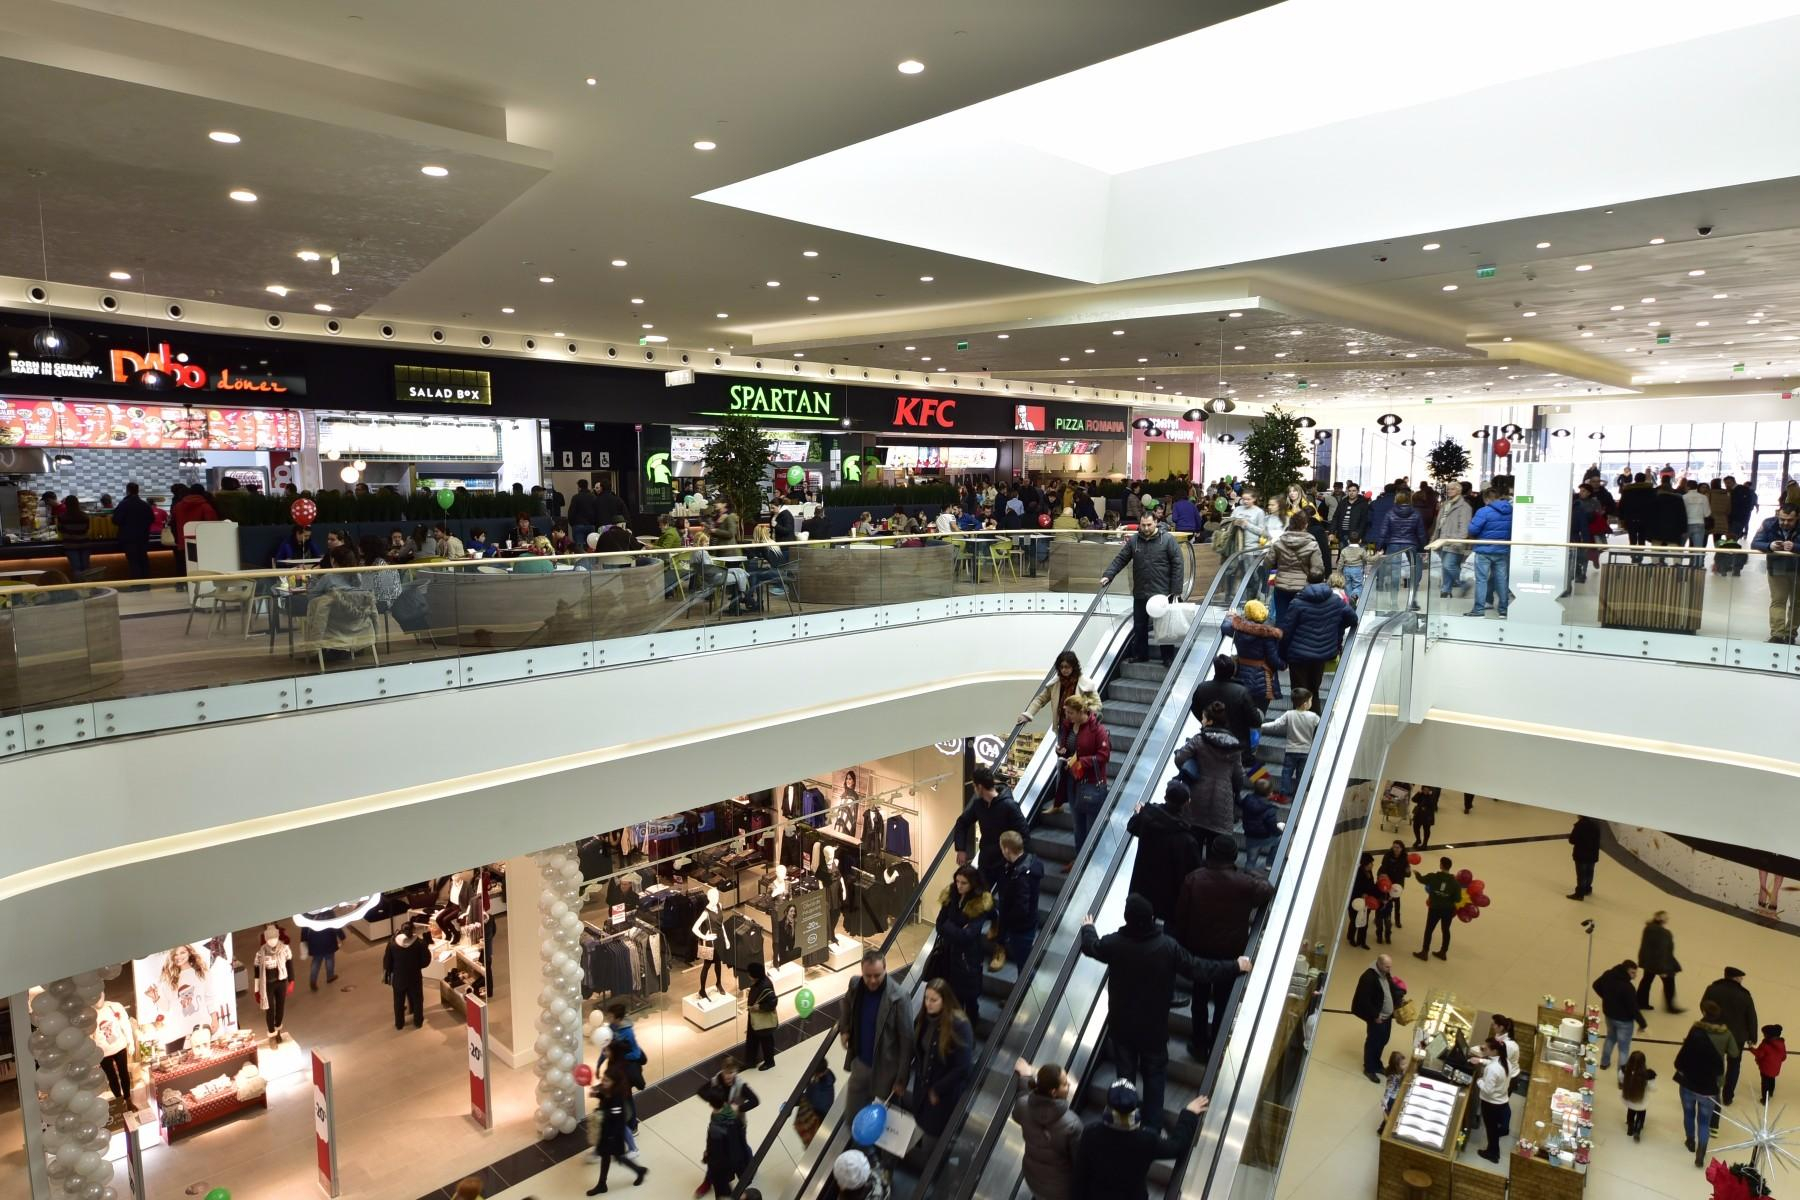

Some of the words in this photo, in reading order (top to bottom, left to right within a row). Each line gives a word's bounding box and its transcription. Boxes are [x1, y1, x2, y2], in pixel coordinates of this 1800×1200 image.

[11, 360, 39, 368] BORN
[54, 369, 95, 378] QUALITY
[409, 387, 453, 398] SALAD
[730, 385, 831, 415] SPARTAN
[893, 397, 956, 428] KFC
[1056, 418, 1084, 431] PIZZA
[1086, 420, 1125, 432] ROMANA
